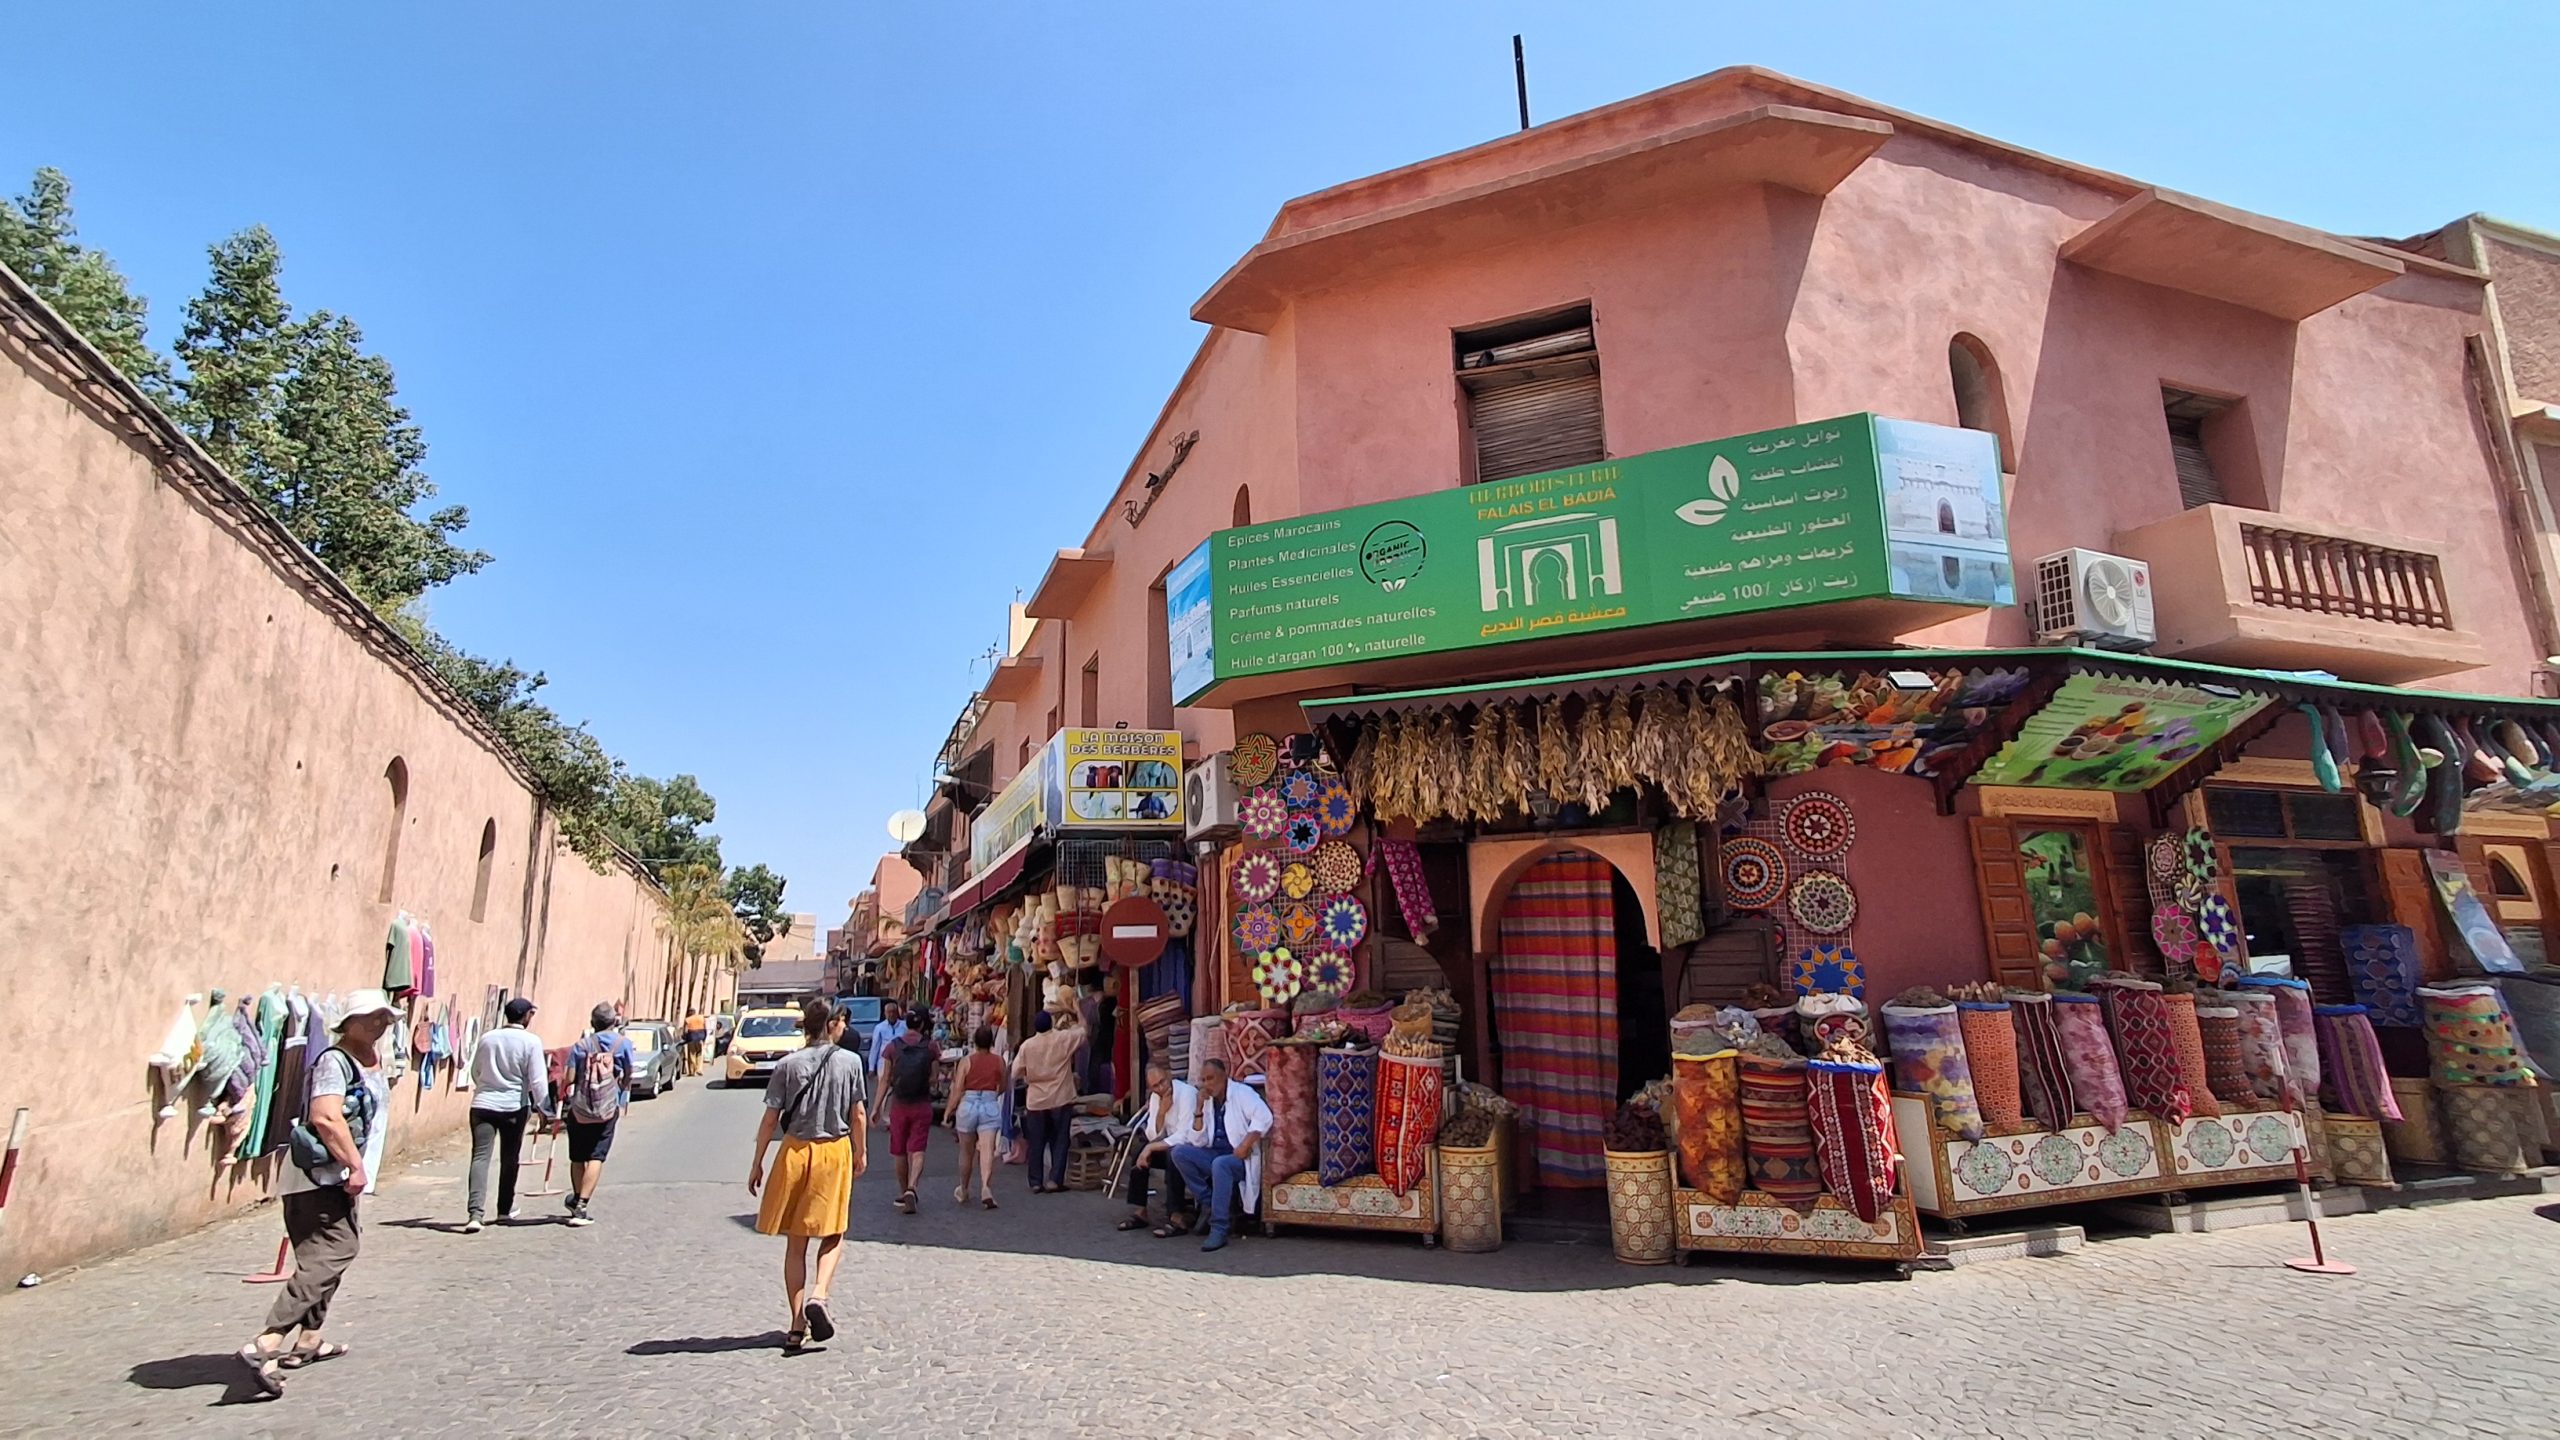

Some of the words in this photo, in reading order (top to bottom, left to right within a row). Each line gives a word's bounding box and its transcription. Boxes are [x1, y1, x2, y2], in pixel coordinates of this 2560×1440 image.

[1538, 496, 1558, 511] EL
[1563, 486, 1617, 507] BADIA
[1228, 533, 1271, 549] Epices
[1273, 518, 1342, 540] Marocains
[1228, 553, 1275, 572] Plantes
[1229, 578, 1269, 596] Huiles
[1272, 566, 1355, 589] Essencielles
[1230, 602, 1282, 620] Parfums
[1286, 593, 1340, 611] naturels
[1275, 626, 1285, 638] &
[1288, 616, 1362, 638] pommades
[1366, 605, 1436, 625] naturelles
[1231, 653, 1263, 669] Huile
[1267, 648, 1317, 667] d'argan
[1321, 643, 1344, 658] 100
[1347, 642, 1360, 654] %
[1364, 633, 1426, 652] naturelle
[1070, 744, 1099, 755] DES
[1081, 732, 1099, 743] LA
[1104, 732, 1165, 744] MAISON
